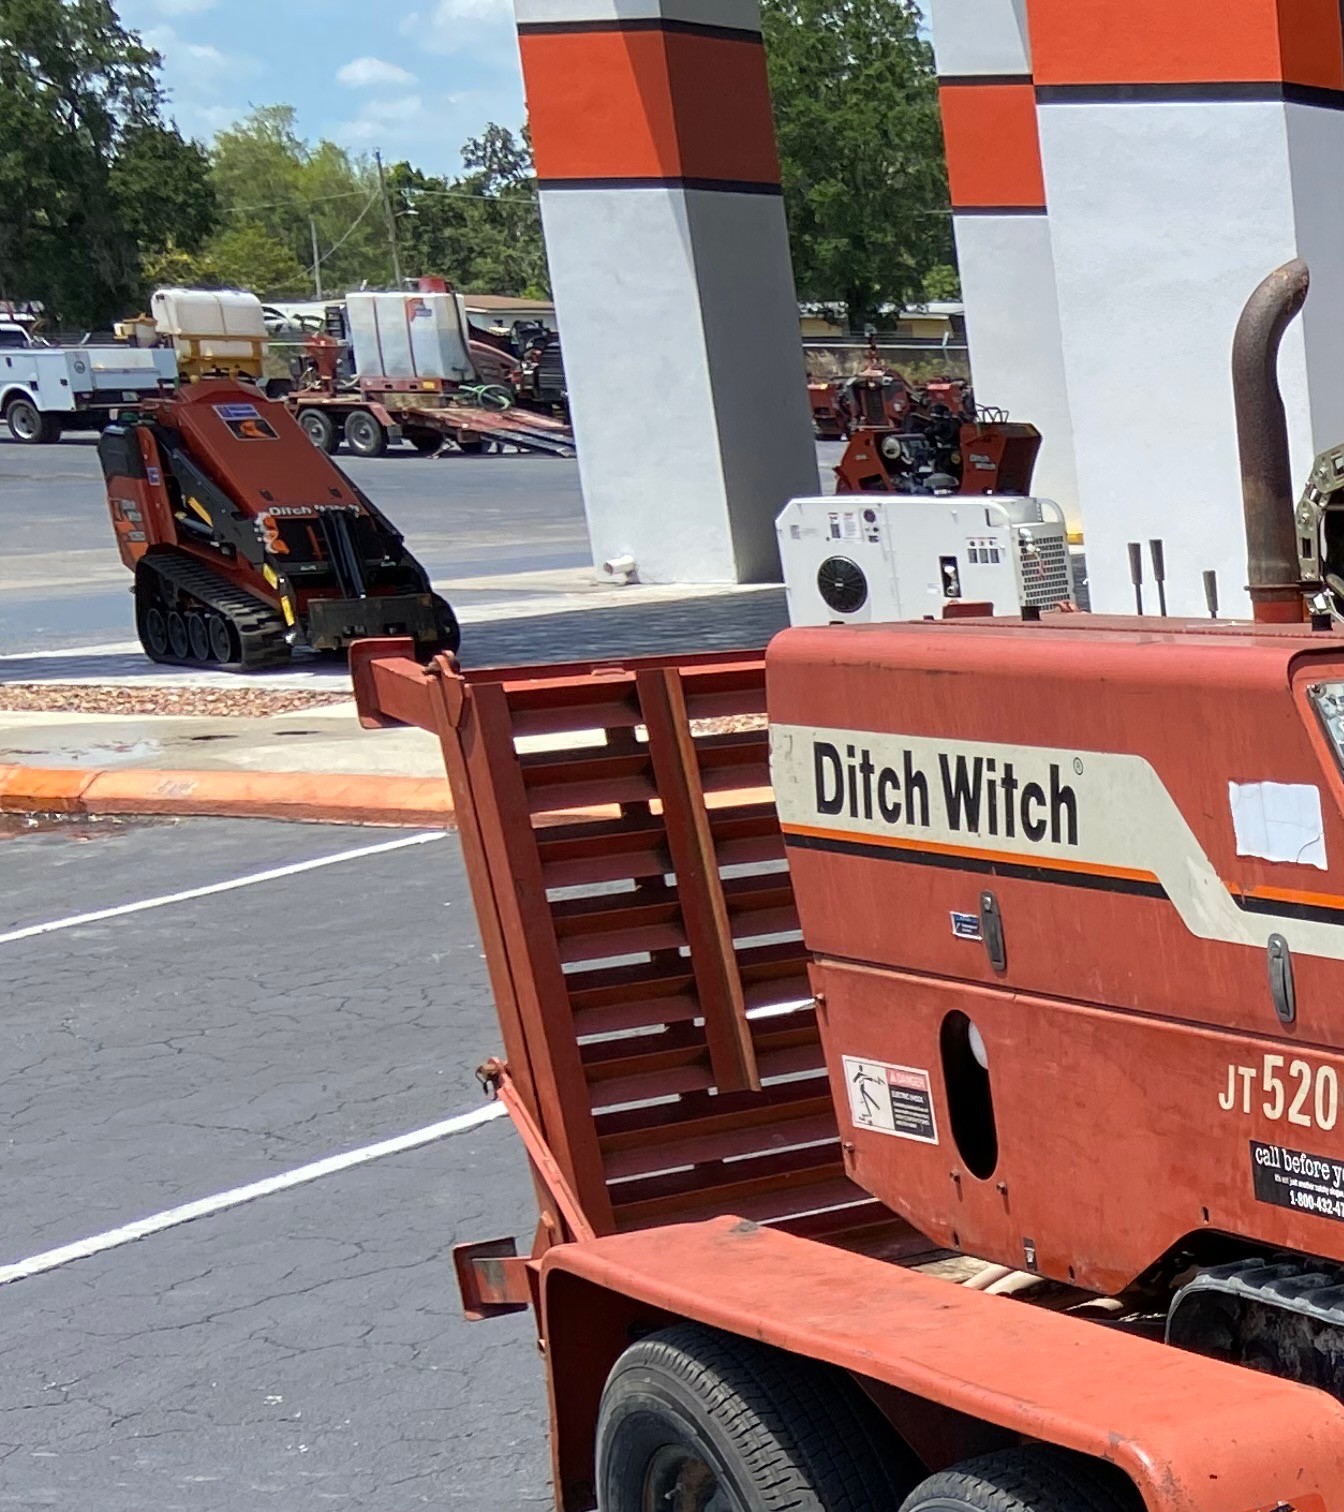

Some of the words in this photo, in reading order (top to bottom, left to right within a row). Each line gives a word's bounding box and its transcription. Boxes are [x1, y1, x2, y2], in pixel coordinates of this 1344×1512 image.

[813, 741, 931, 828] Ditch
[937, 752, 1079, 846] Witch
[1255, 1145, 1281, 1169] call
[1282, 1149, 1332, 1181] before
